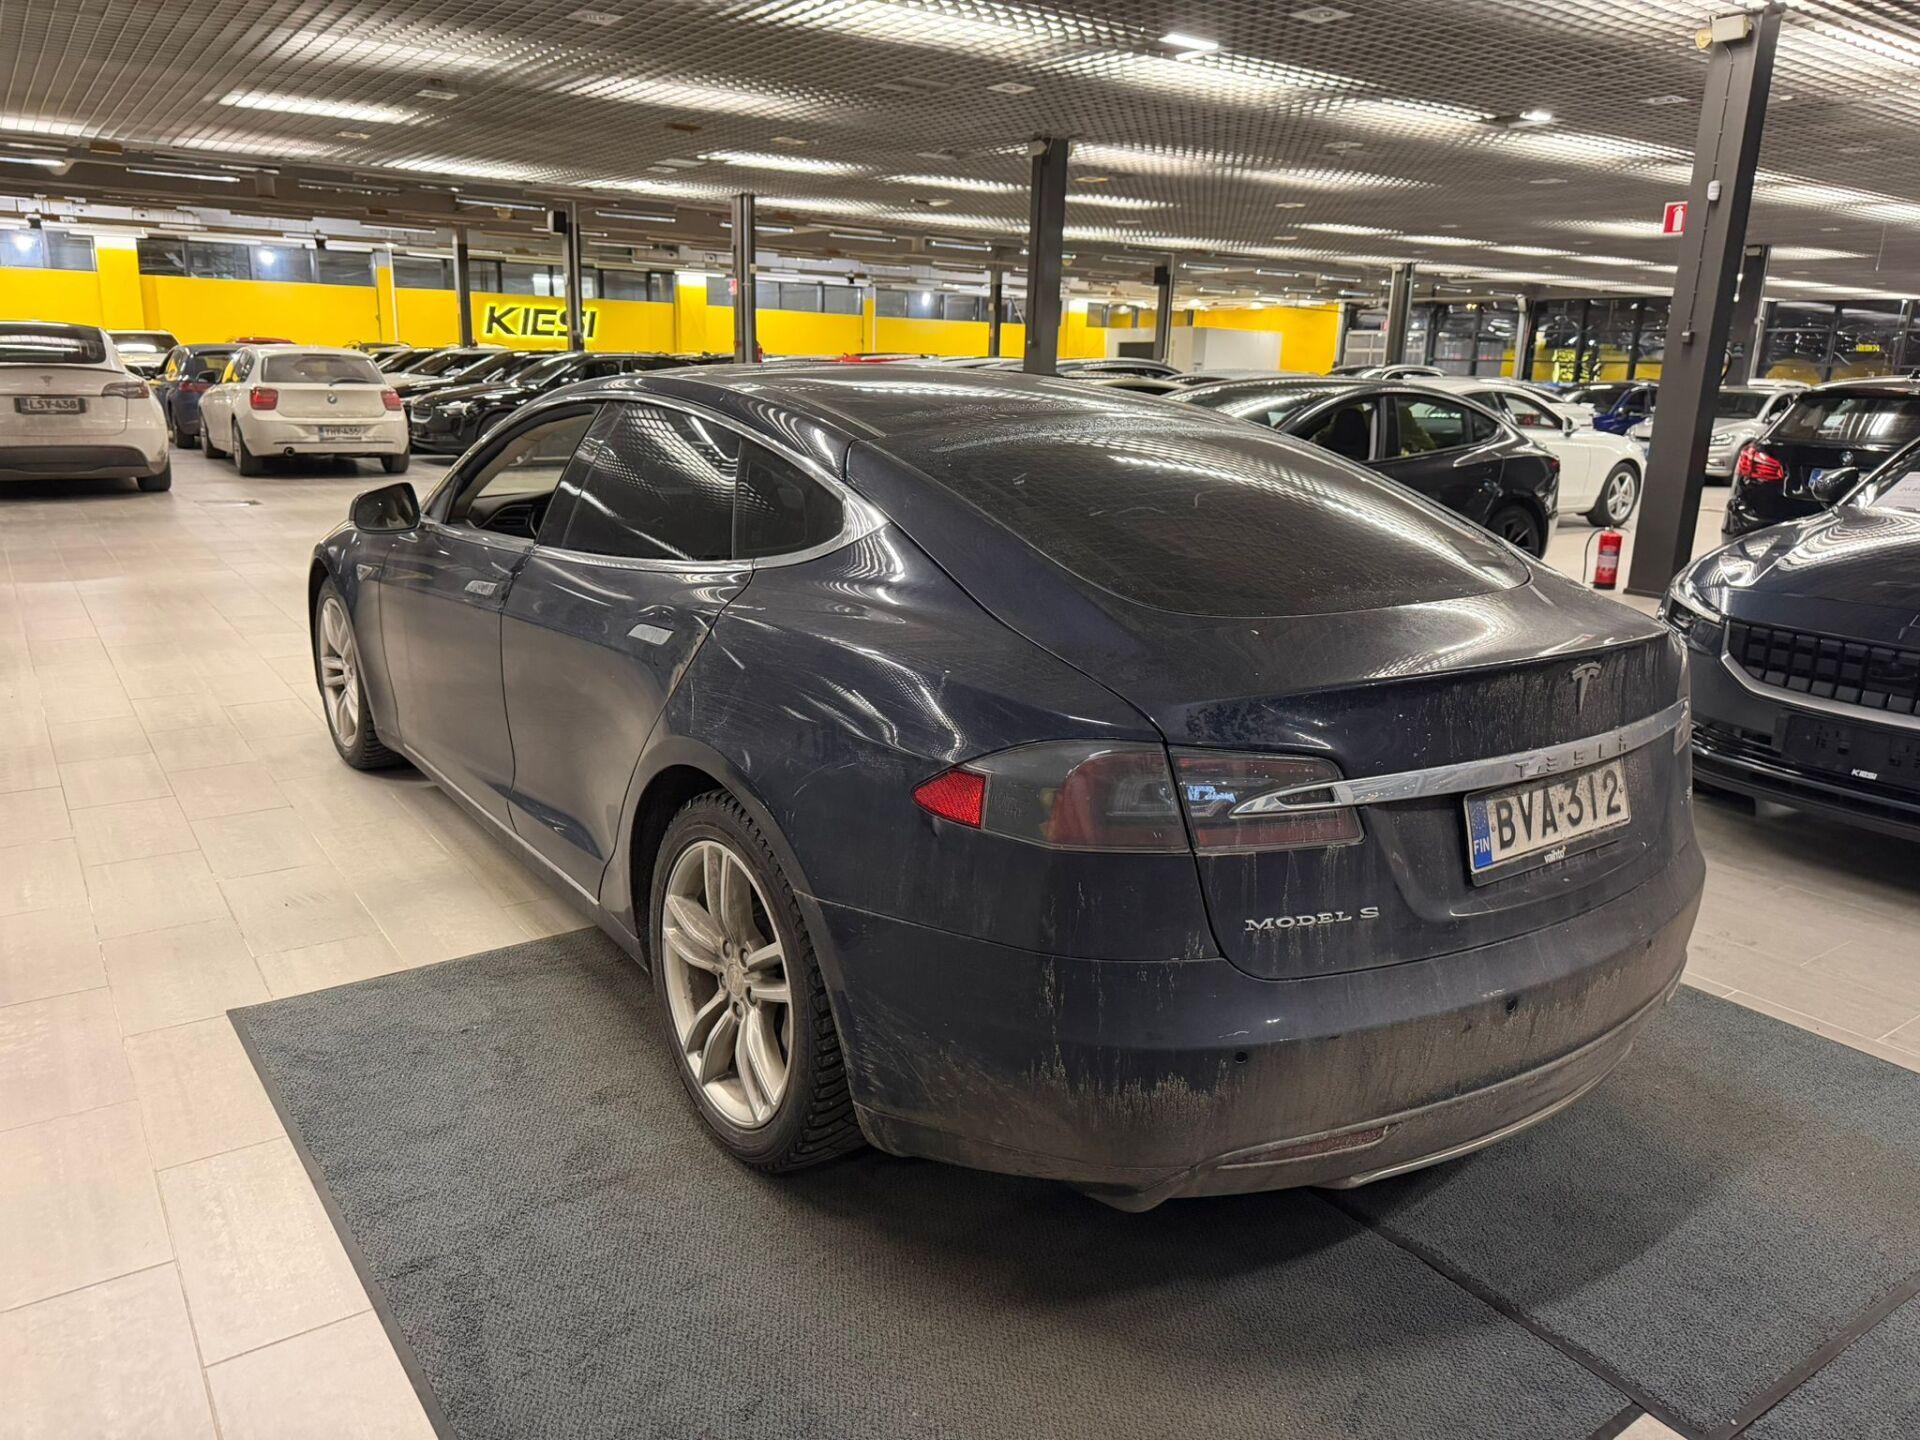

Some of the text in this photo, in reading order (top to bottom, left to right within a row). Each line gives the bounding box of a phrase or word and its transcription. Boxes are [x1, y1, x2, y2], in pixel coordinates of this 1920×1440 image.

[1495, 769, 1621, 850] BVA-312
[1473, 837, 1490, 855] FIN
[1245, 906, 1380, 931] MODEL S
